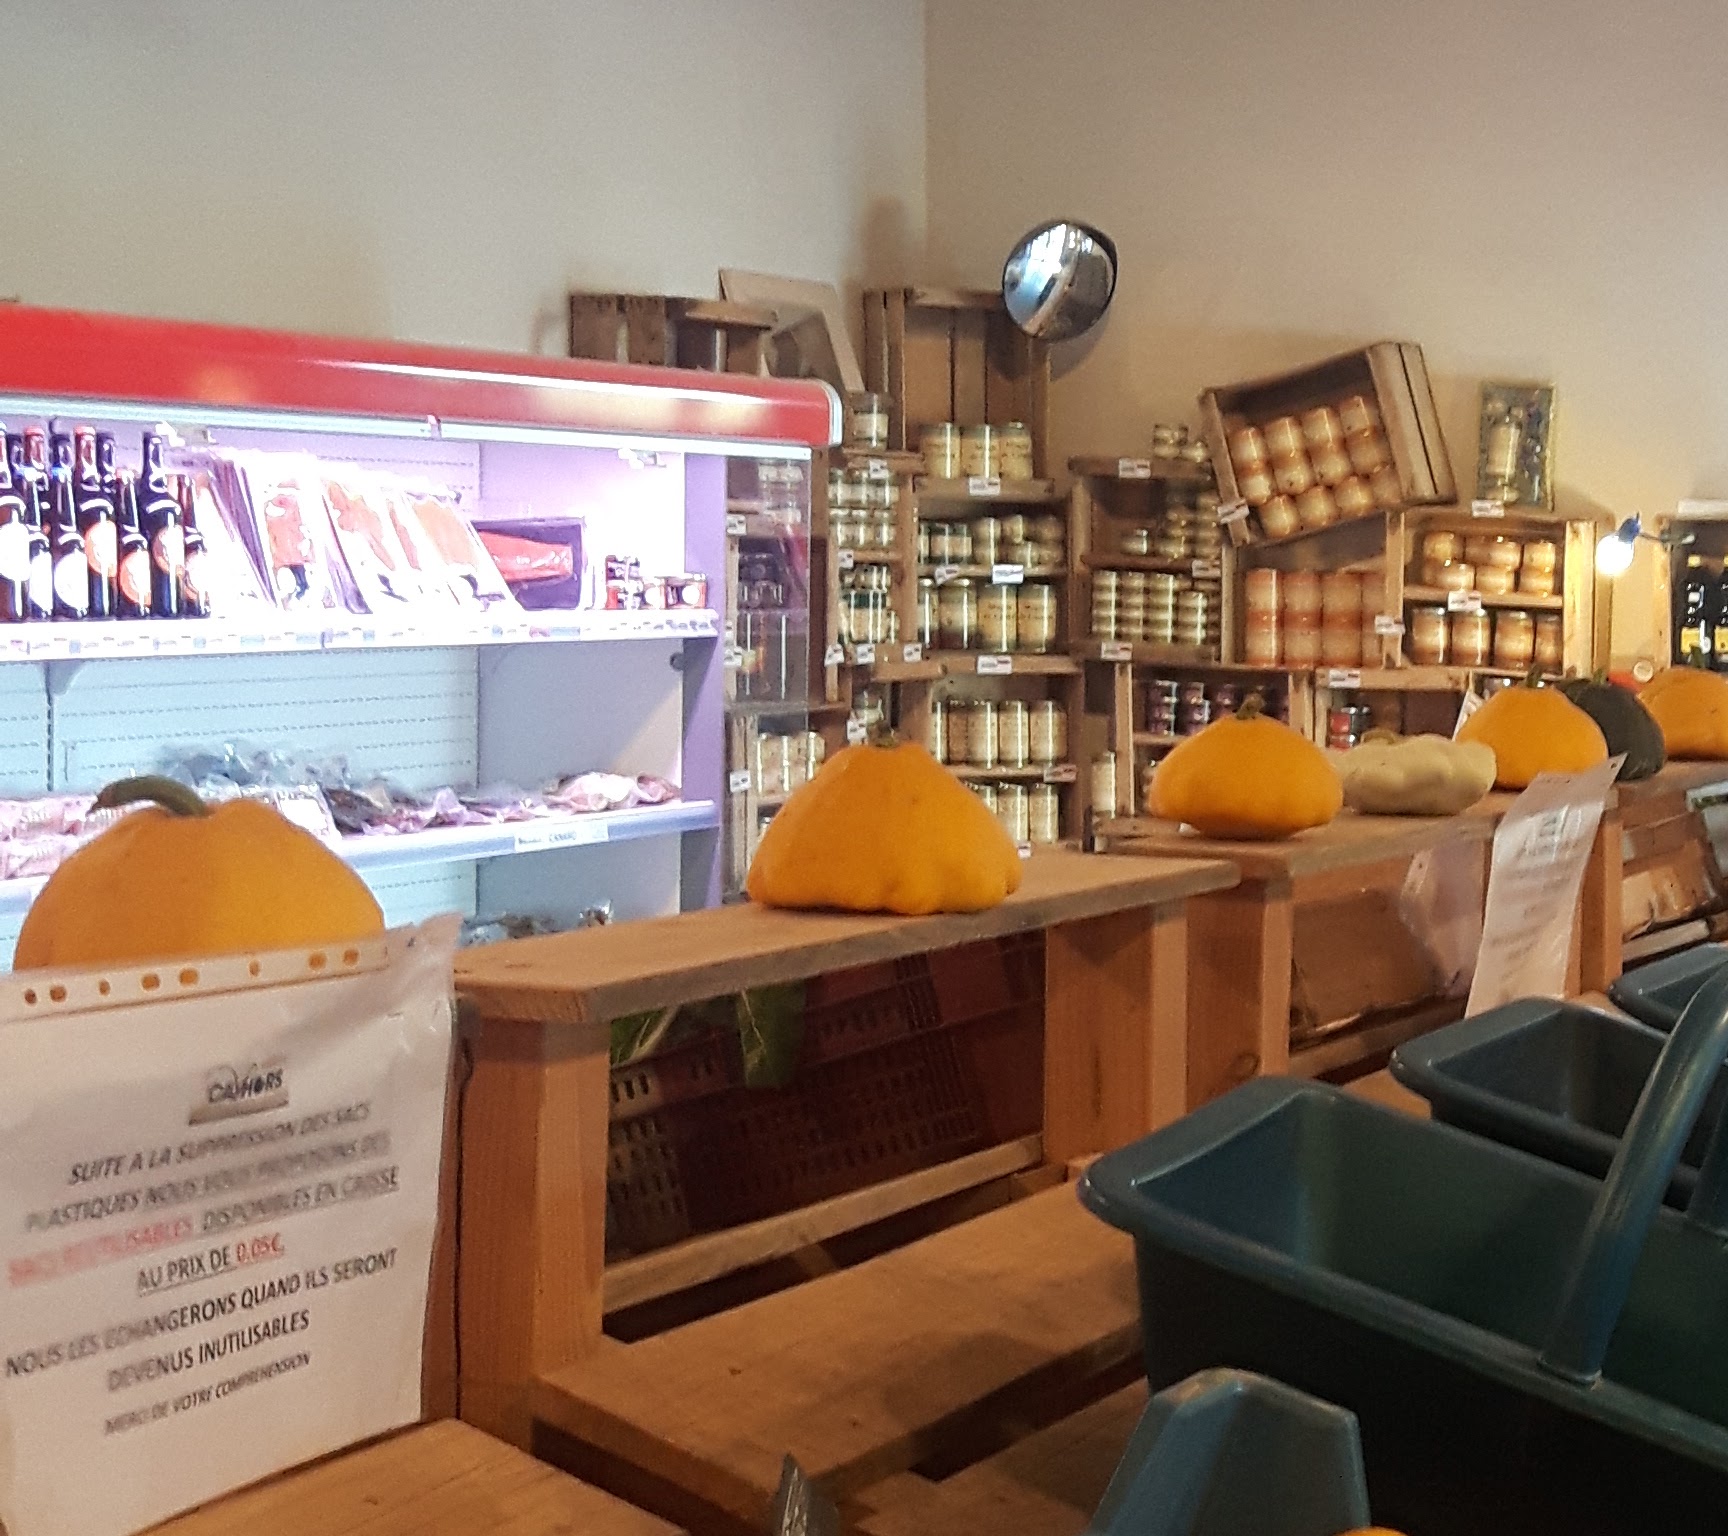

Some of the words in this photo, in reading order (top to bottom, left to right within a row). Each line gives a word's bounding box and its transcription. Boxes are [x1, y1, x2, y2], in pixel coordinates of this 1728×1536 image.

[68, 1155, 126, 1185] SUITE
[149, 1146, 171, 1169] LA
[138, 1267, 163, 1291] AU
[167, 1253, 206, 1282] PRIX
[210, 1245, 230, 1271] DE
[5, 1344, 61, 1377] NOUS
[241, 1273, 300, 1310] QUAND
[305, 1266, 328, 1290] ILS
[333, 1248, 397, 1284] SERONT
[108, 1346, 194, 1392] DEVENUS
[199, 1309, 310, 1364] INUTILISABLES
[172, 1385, 212, 1413] VOTRE
